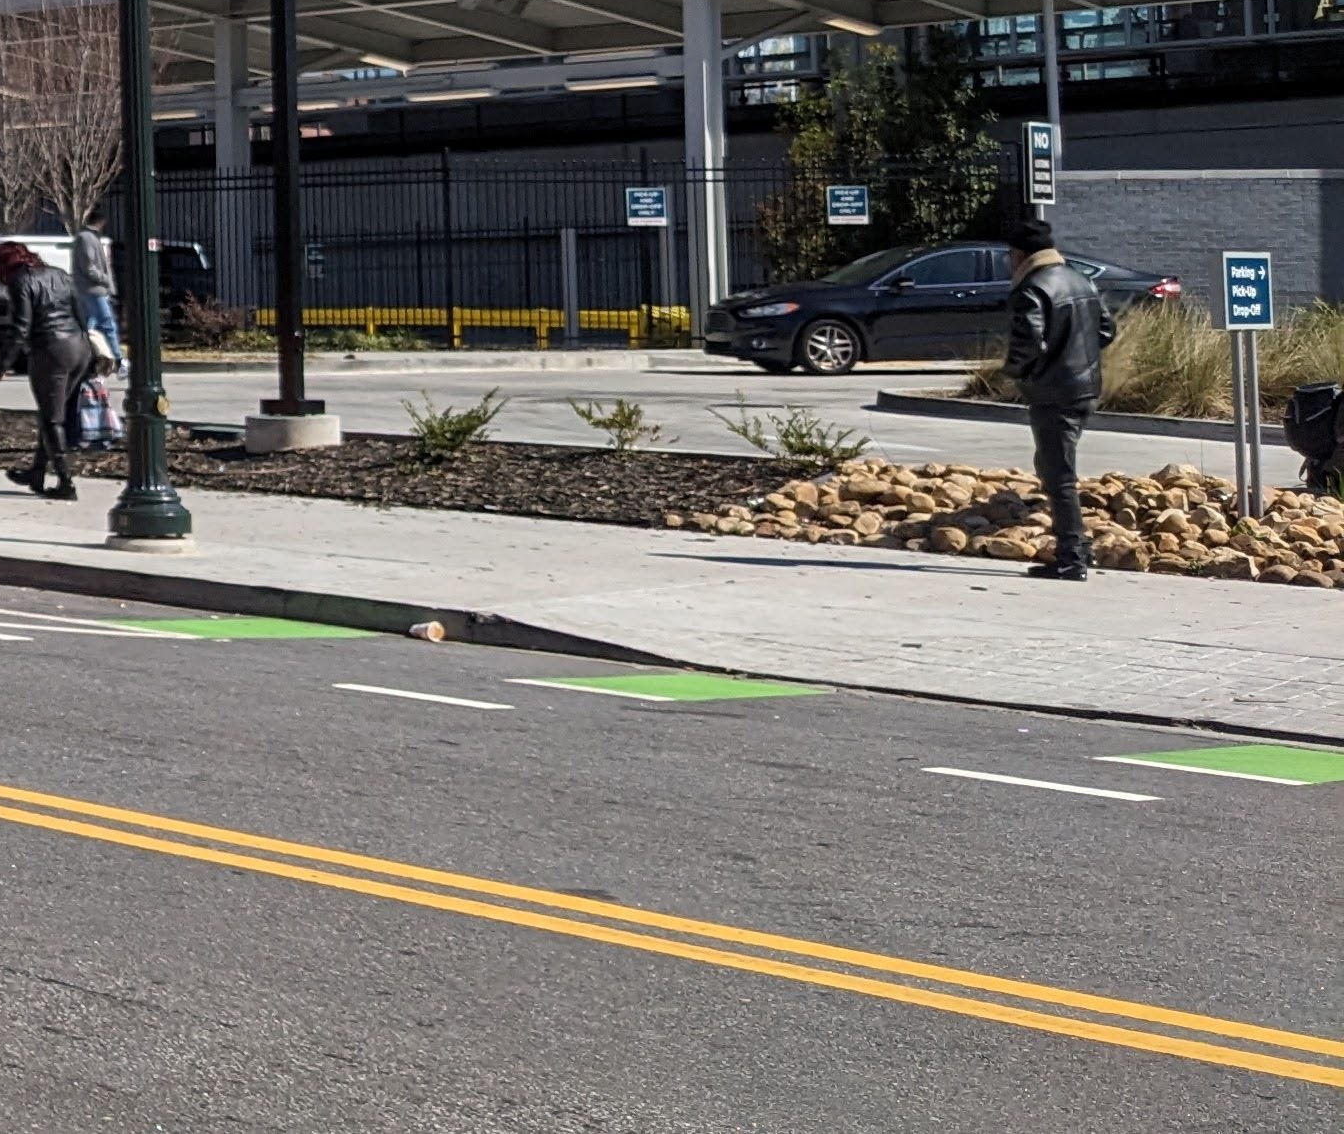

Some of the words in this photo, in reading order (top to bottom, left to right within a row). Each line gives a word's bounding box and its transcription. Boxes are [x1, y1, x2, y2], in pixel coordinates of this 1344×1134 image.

[1033, 132, 1049, 149] NO
[1231, 266, 1255, 281] Parking
[1232, 285, 1257, 299] Pick-Up
[1233, 303, 1261, 319] Drop-Off
